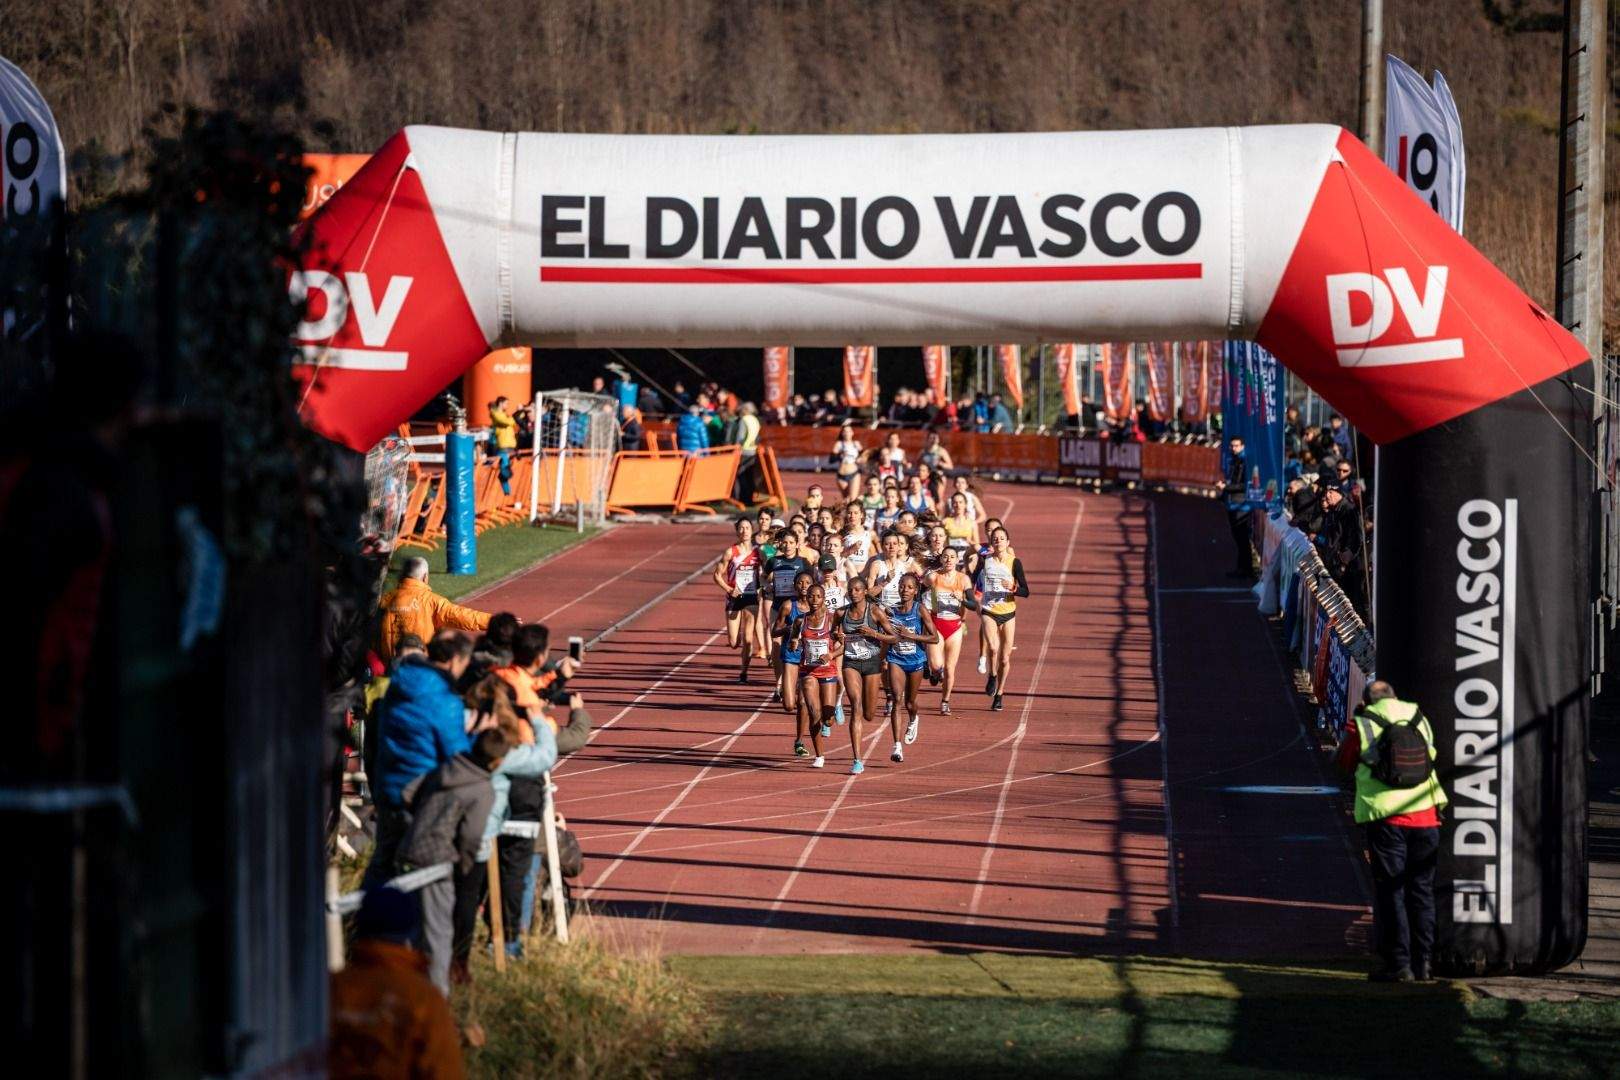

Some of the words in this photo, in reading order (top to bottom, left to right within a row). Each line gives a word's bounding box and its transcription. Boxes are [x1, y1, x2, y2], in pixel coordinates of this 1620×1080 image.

[541, 195, 630, 259] EL
[646, 196, 920, 260] DIARIO
[934, 191, 1201, 259] VASCO
[289, 270, 414, 347] DV
[1326, 265, 1448, 345] DV
[825, 597, 838, 607] 38
[1456, 499, 1503, 671] VASCO
[1453, 677, 1501, 857] DIARIO
[1452, 864, 1499, 925] EL
